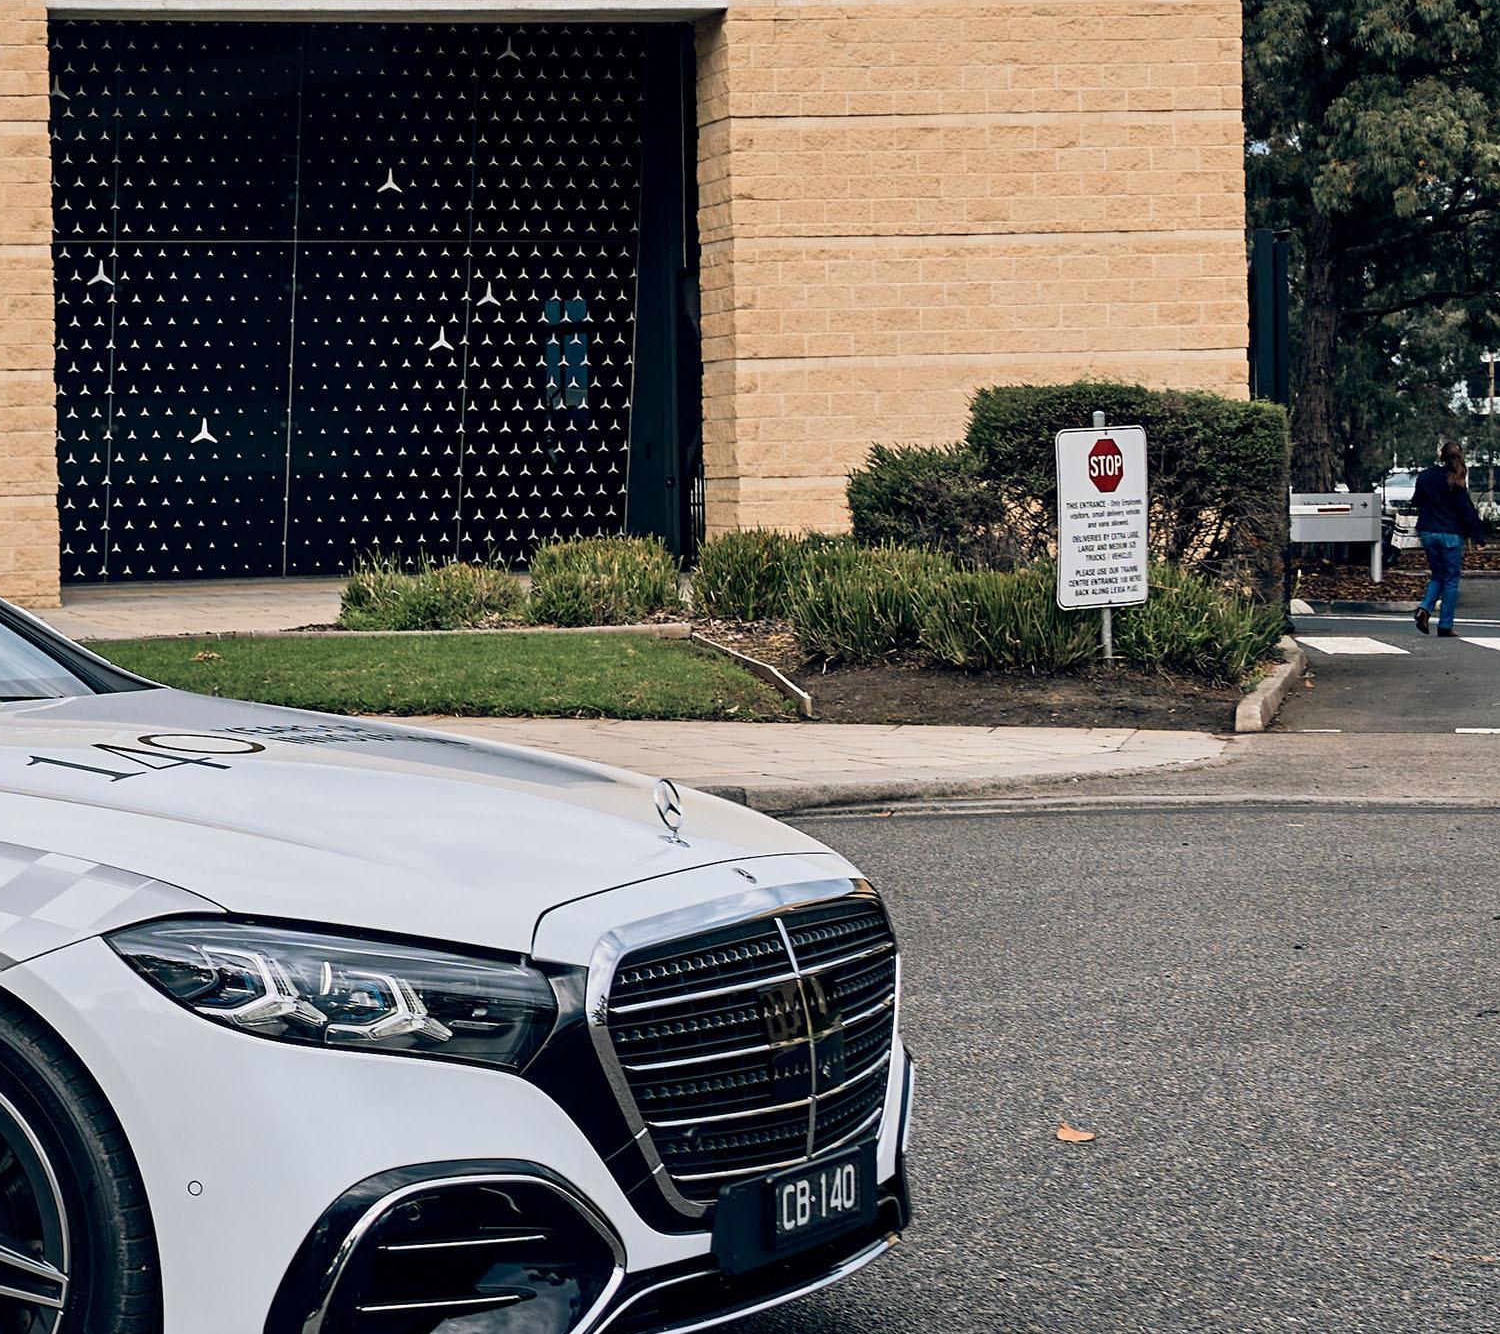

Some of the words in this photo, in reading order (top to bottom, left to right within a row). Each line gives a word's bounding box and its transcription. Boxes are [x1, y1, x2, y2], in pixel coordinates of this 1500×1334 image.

[1090, 454, 1122, 477] STOP
[1079, 500, 1106, 509] ENTRANCE
[25, 733, 267, 783] 140
